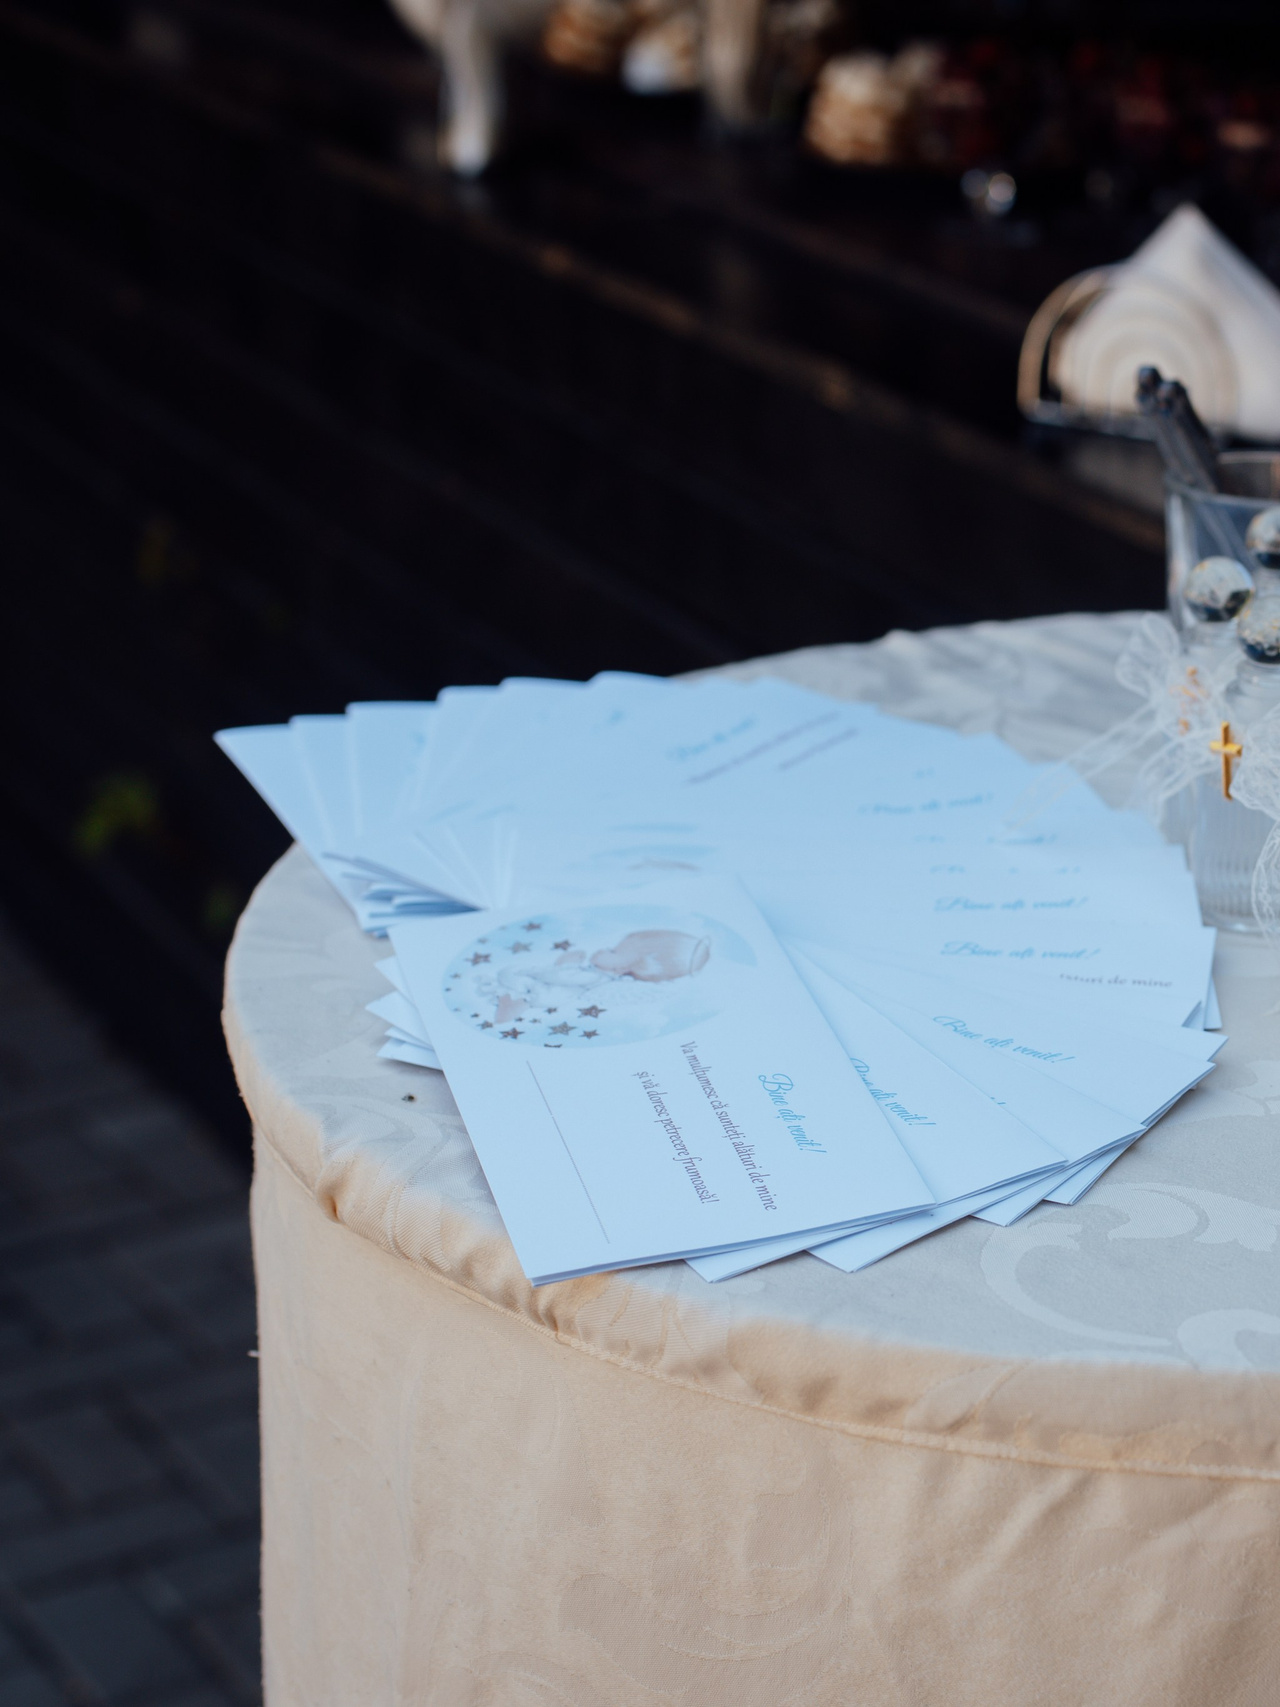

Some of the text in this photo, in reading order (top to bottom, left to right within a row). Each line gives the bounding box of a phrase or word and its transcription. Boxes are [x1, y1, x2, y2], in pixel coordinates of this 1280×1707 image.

[643, 1077, 661, 1091] vă
[686, 1053, 719, 1100] mulțumesc
[647, 1090, 670, 1118] doresc
[710, 1099, 729, 1111] că
[758, 1073, 828, 1153] Bine ați venit!
[885, 1101, 937, 1126] venit!
[654, 1117, 690, 1157] petrecere
[716, 1109, 746, 1142] sunteți
[732, 1140, 763, 1171] alături
[672, 1156, 720, 1204] frumoasă!
[749, 1170, 771, 1184] de
[756, 1183, 778, 1212] mine
